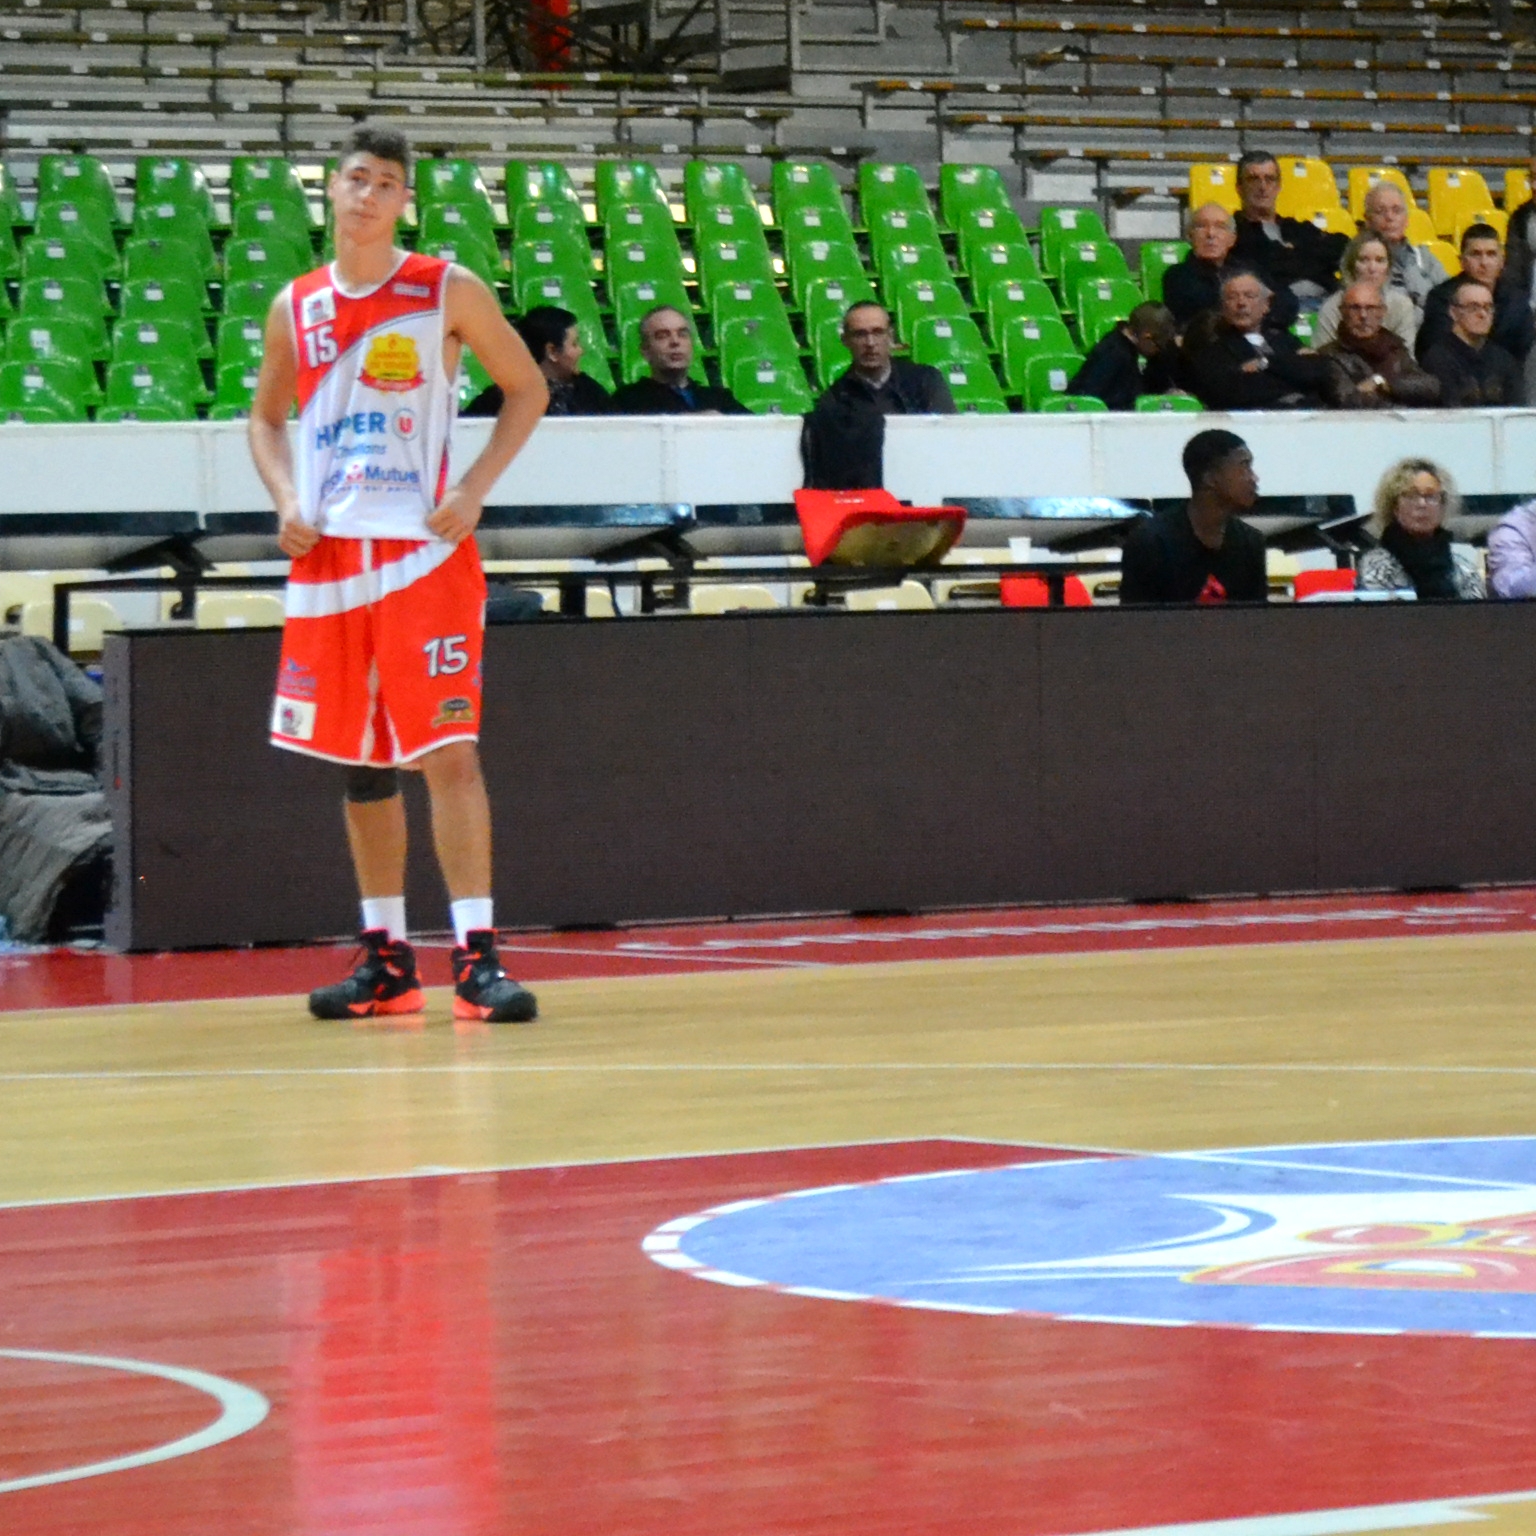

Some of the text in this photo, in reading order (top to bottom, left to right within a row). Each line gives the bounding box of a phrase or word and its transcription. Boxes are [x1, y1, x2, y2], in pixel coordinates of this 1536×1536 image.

[303, 324, 339, 369] 15
[397, 416, 413, 434] U
[422, 633, 470, 679] 15
